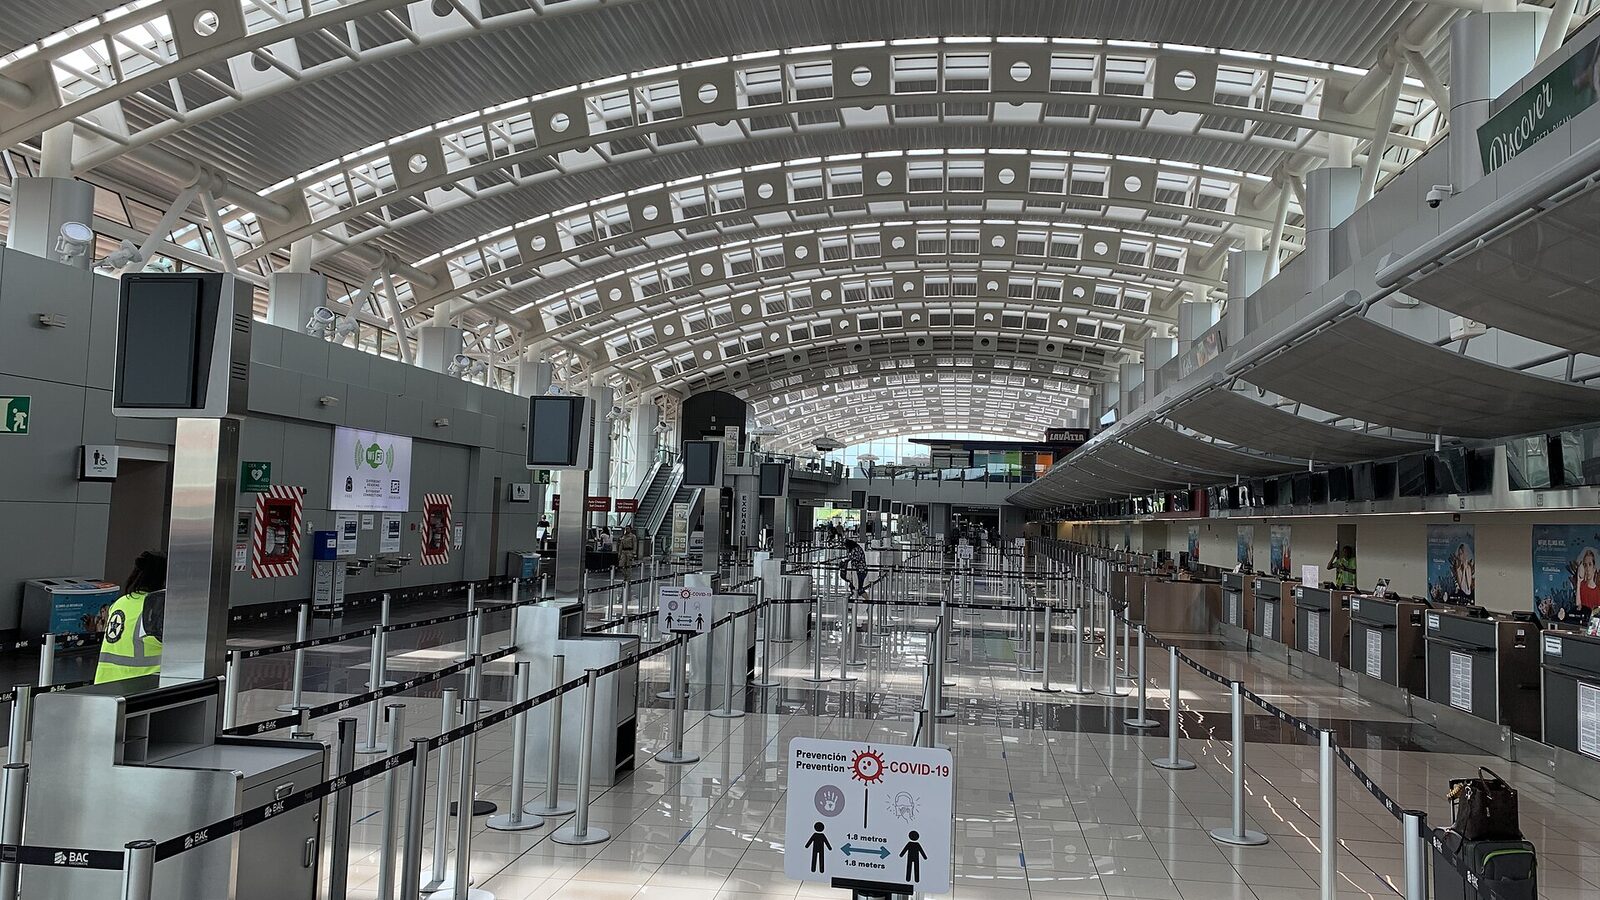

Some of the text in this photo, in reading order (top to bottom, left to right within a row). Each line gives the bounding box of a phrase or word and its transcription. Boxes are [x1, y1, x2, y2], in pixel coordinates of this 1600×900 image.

[1490, 82, 1552, 172] Discover
[1050, 431, 1084, 441] LAVAZZA
[796, 750, 847, 761] Prevención
[796, 761, 845, 772] Prevention
[890, 762, 949, 777] COVID-19
[273, 800, 284, 812] BAC
[195, 829, 208, 842] BAC
[69, 852, 89, 862] BAC
